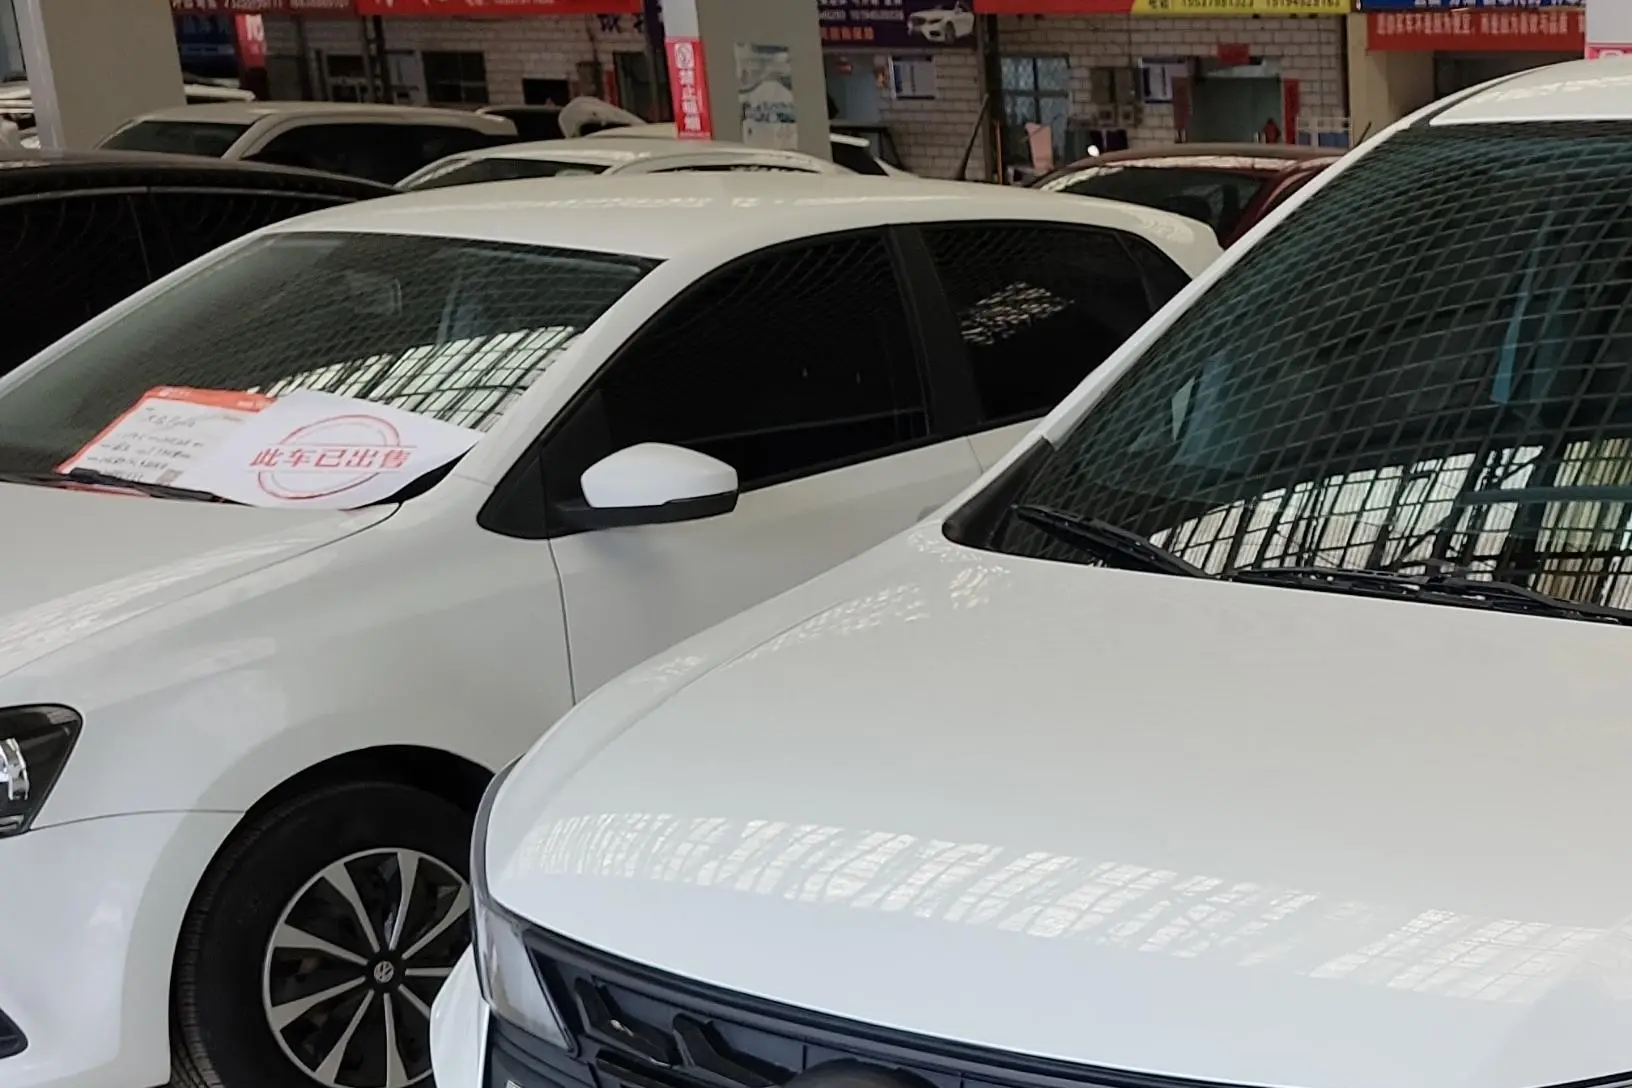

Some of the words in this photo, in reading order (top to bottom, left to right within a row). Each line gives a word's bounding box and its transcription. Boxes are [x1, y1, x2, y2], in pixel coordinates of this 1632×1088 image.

[250, 448, 411, 469] 此车已出售
